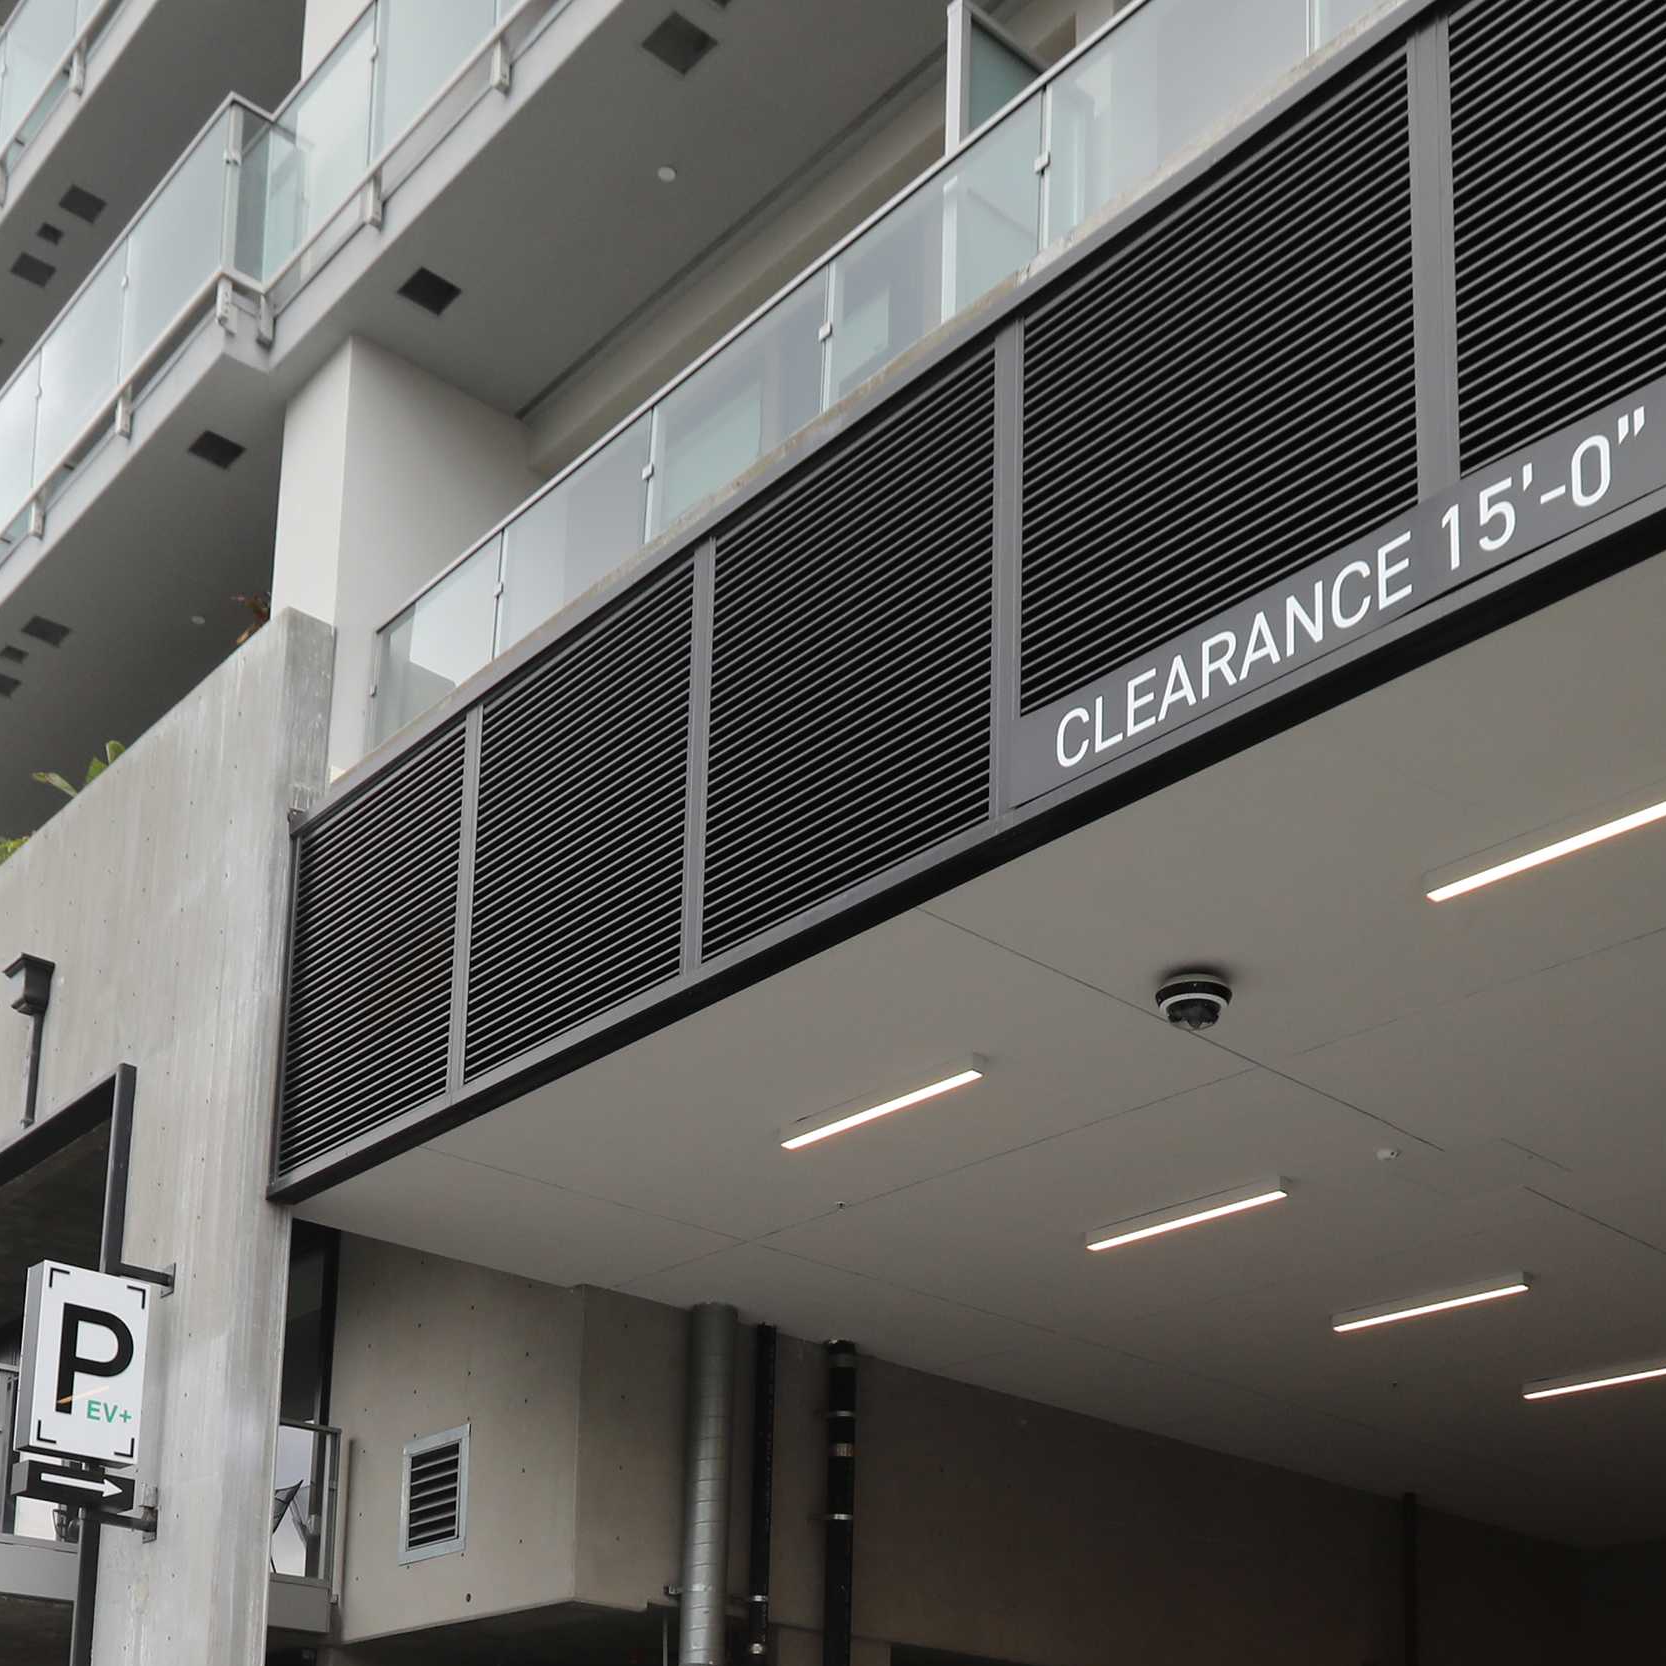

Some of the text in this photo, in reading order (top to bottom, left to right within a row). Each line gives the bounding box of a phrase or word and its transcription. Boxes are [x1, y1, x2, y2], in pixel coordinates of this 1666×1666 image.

[1055, 405, 1646, 769] CLEARANCE 15'-0"
[55, 1302, 134, 1415] P
[85, 1400, 133, 1424] EV+
